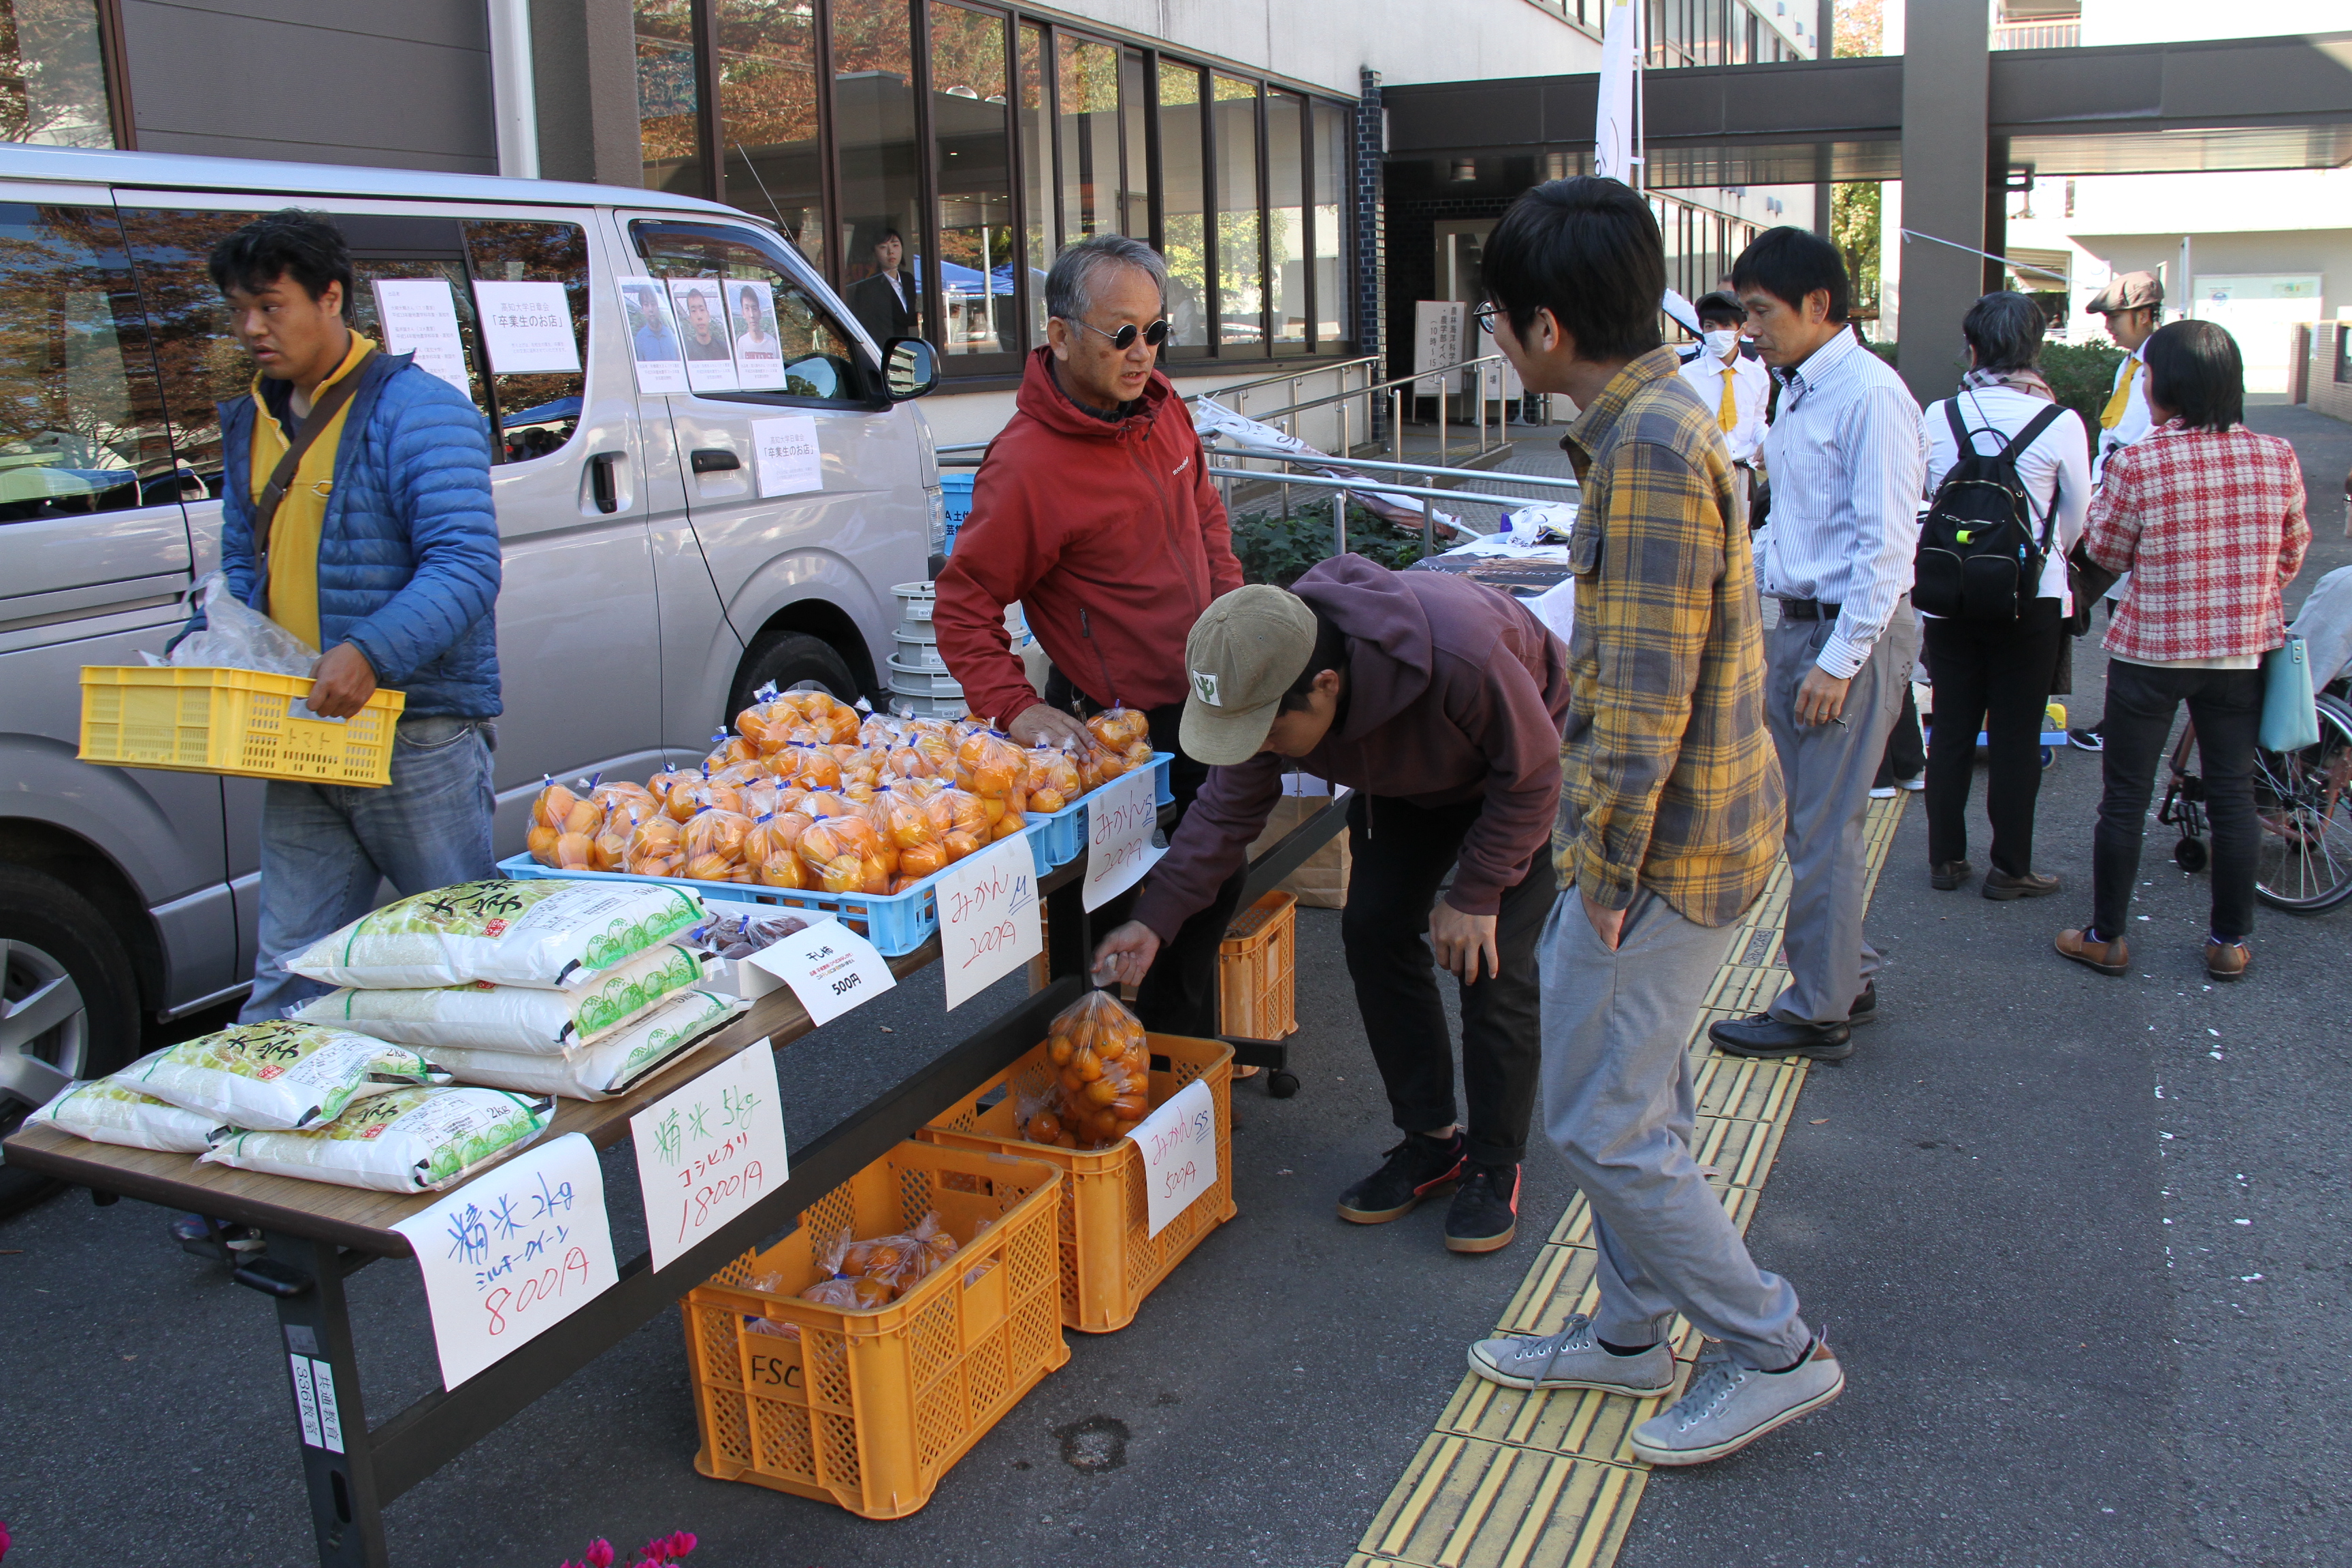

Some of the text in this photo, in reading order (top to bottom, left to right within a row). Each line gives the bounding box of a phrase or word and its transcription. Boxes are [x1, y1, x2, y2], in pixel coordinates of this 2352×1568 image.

[492, 314, 563, 328] 「卒業生のお店」
[501, 302, 550, 312] 高知大学日章会
[764, 443, 814, 459] 「卒業生のお店」
[770, 434, 804, 444] 高知大学日章会
[289, 728, 331, 750] トマト
[1095, 790, 1146, 845] みかん
[1094, 838, 1143, 882] 200円
[634, 886, 663, 896] 5kg
[950, 865, 1009, 924] みかん
[805, 945, 834, 962] 干し柿
[962, 919, 1016, 969] 200円
[672, 992, 699, 1004] 5kg
[832, 973, 862, 996] 500円
[486, 1105, 511, 1119] 2kg
[653, 1084, 762, 1166] 精米 5kg
[1151, 1106, 1194, 1166] みかん
[678, 1132, 748, 1188] コシヒカリ
[1164, 1161, 1196, 1198] 500円
[447, 1171, 576, 1265] 精米 2kg
[678, 1160, 764, 1244] 1800円
[485, 1247, 590, 1335] 800円
[752, 1355, 801, 1388] FSC
[297, 1366, 318, 1437] 336教室
[317, 1372, 340, 1442] 共通教育
